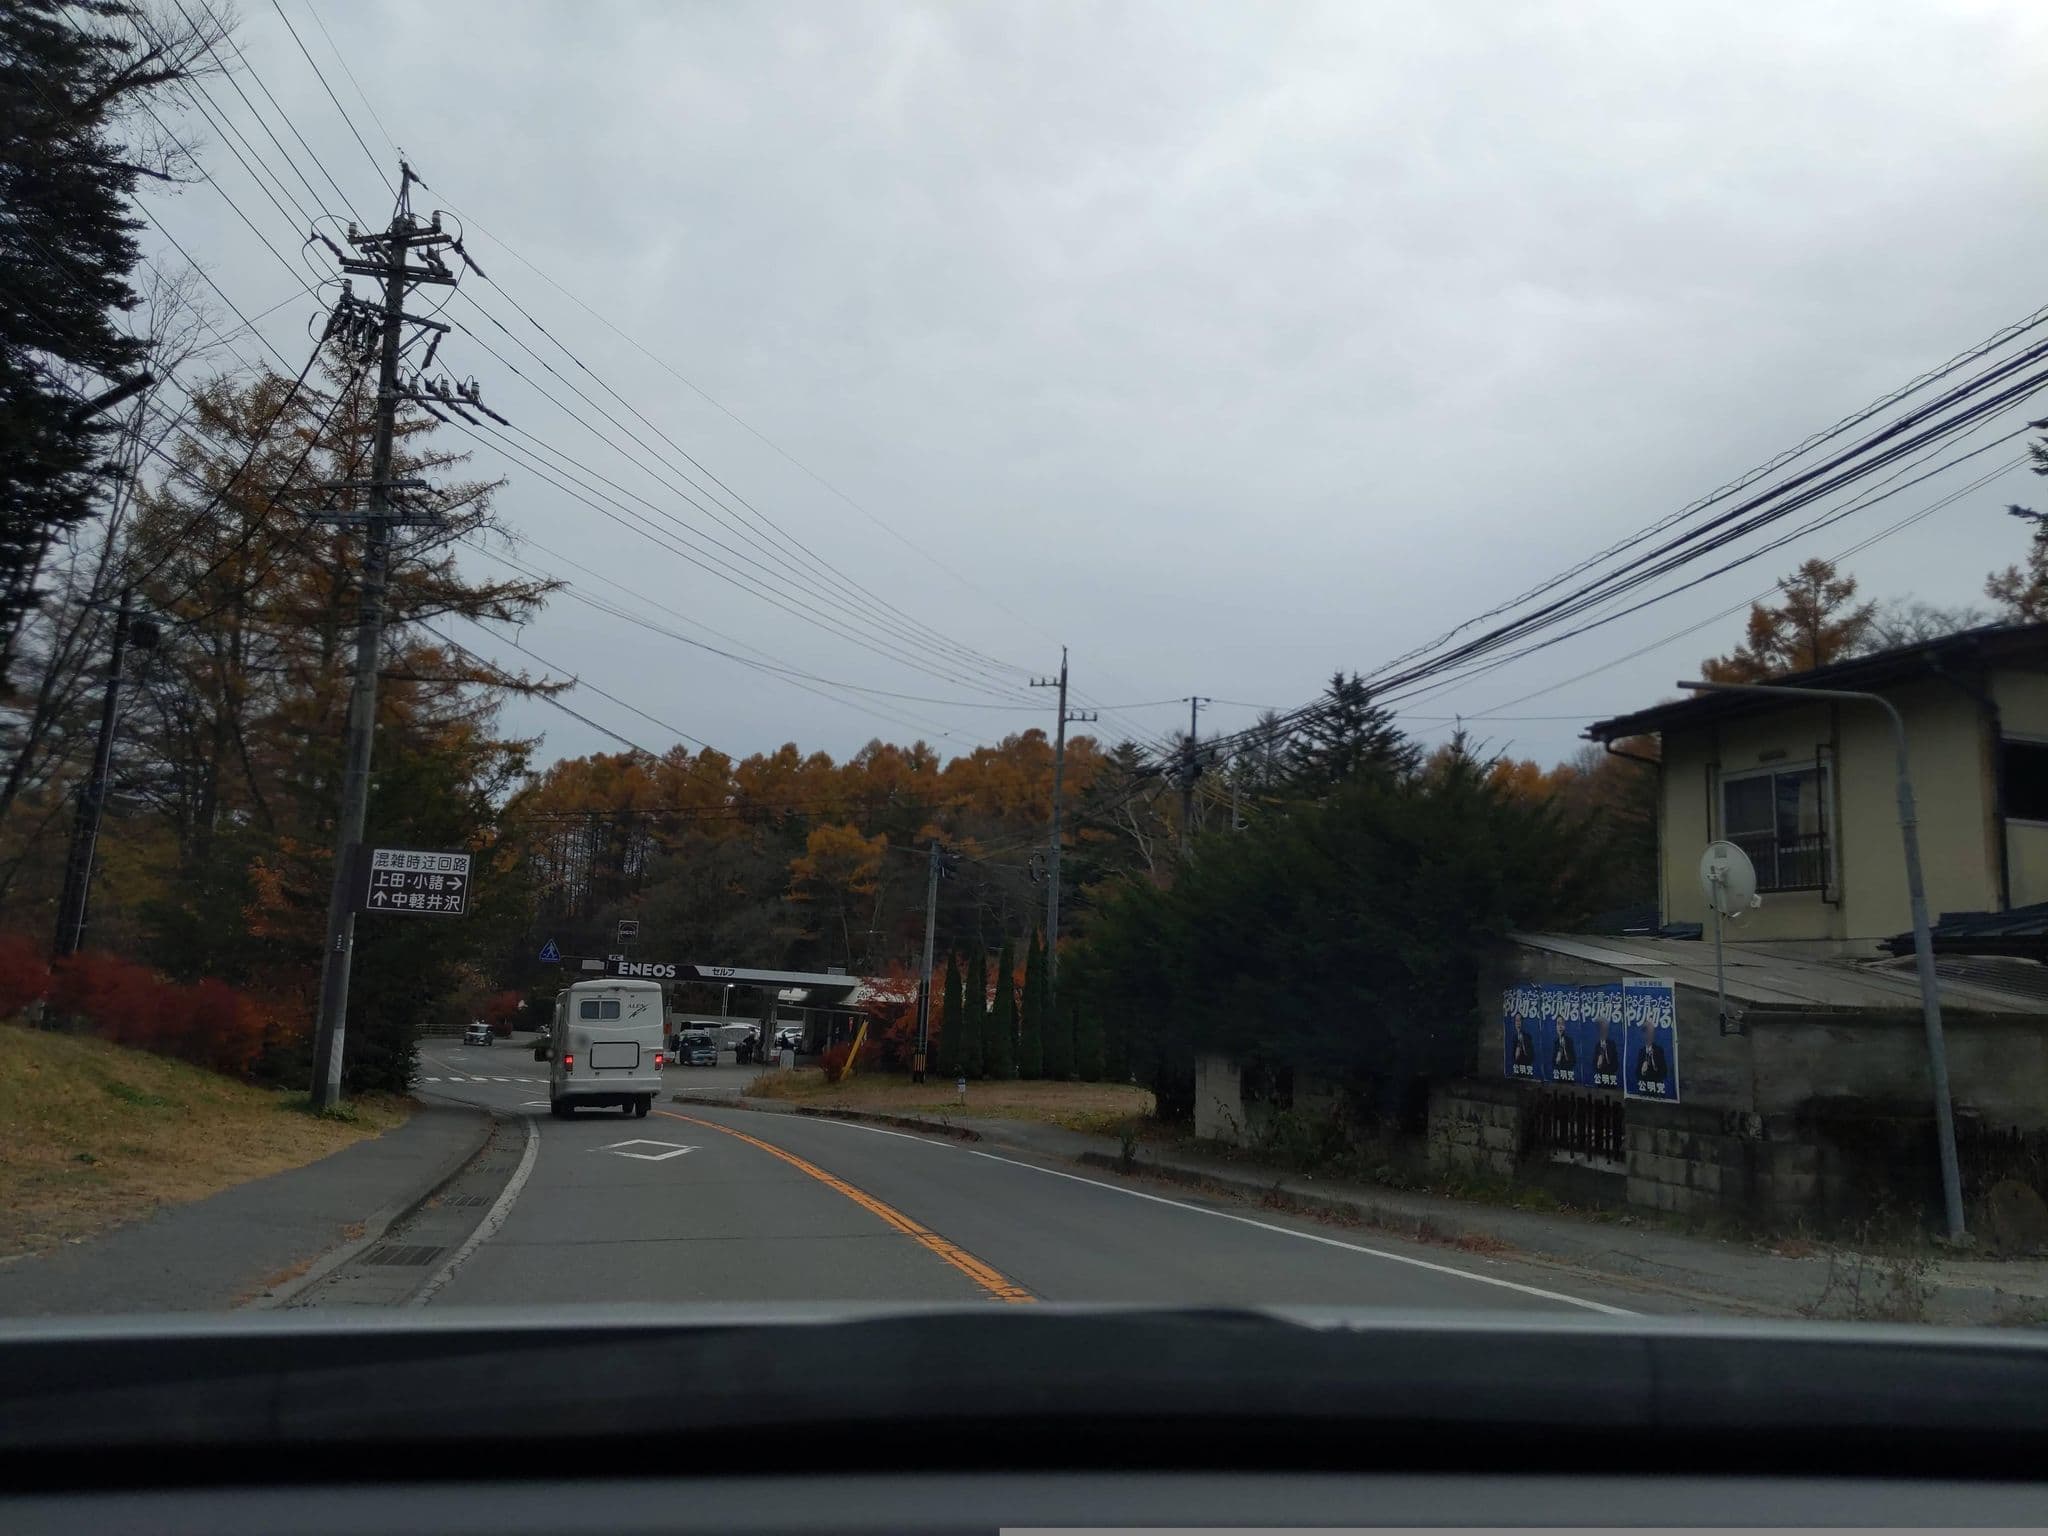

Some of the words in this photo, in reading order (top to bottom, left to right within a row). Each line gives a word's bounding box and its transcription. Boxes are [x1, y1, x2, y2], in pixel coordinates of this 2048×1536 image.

[375, 852, 468, 871] 混雑時迂回路
[374, 871, 444, 891] 上田・小諸
[391, 891, 461, 911] 中軽井沢
[618, 962, 676, 978] ENEOS
[712, 967, 736, 977] セルフ
[1513, 1064, 1533, 1075] 公明党
[1553, 1069, 1575, 1081] 公明党
[1594, 1073, 1618, 1085] 公明党
[1638, 1080, 1666, 1094] 公明党
